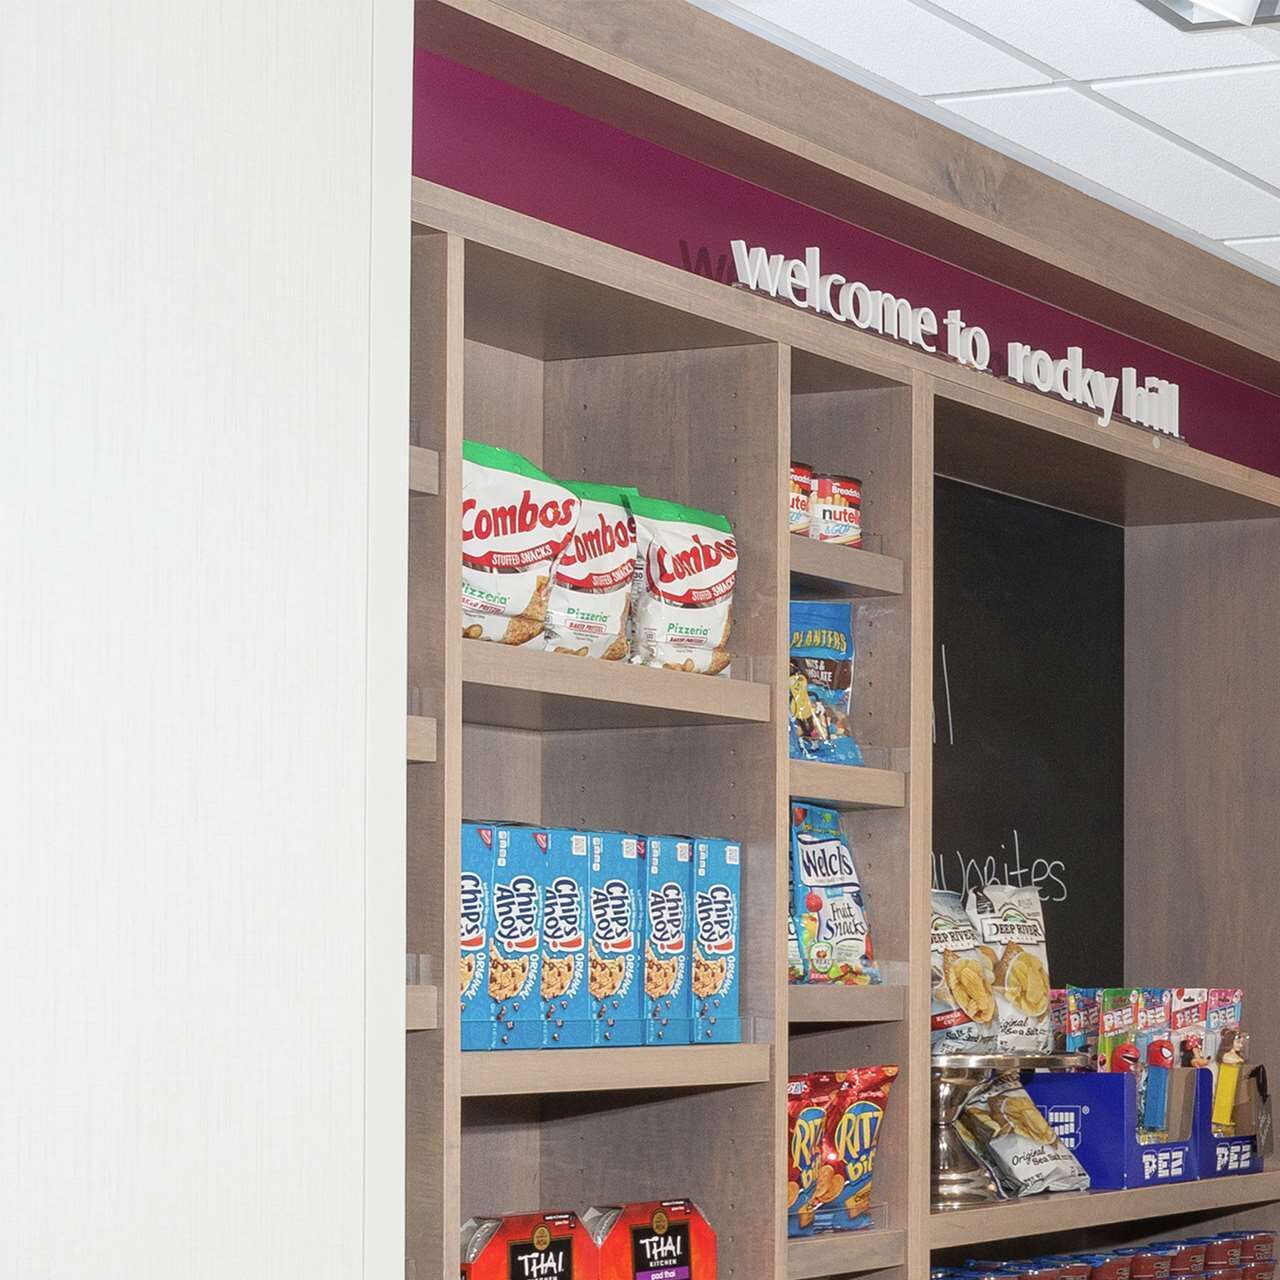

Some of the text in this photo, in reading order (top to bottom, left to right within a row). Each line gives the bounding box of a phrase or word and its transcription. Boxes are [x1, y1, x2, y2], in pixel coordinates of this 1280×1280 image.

[730, 240, 1180, 438] welcome to rocky hill
[520, 541, 553, 564] SNACKS
[462, 581, 508, 606] izzeria
[512, 876, 536, 938] Chips
[554, 879, 579, 940] Chips
[605, 881, 629, 943] Chips
[662, 884, 682, 946] Chips
[710, 886, 730, 945] Chips
[1103, 1007, 1134, 1030] PEZ
[1208, 1005, 1236, 1028] PEZ
[1142, 1150, 1186, 1180] PEZ
[1216, 1143, 1252, 1172] PEZ
[639, 1236, 682, 1260] THAI
[517, 1251, 564, 1278] THAI
[649, 1258, 677, 1268] KITCHEN
